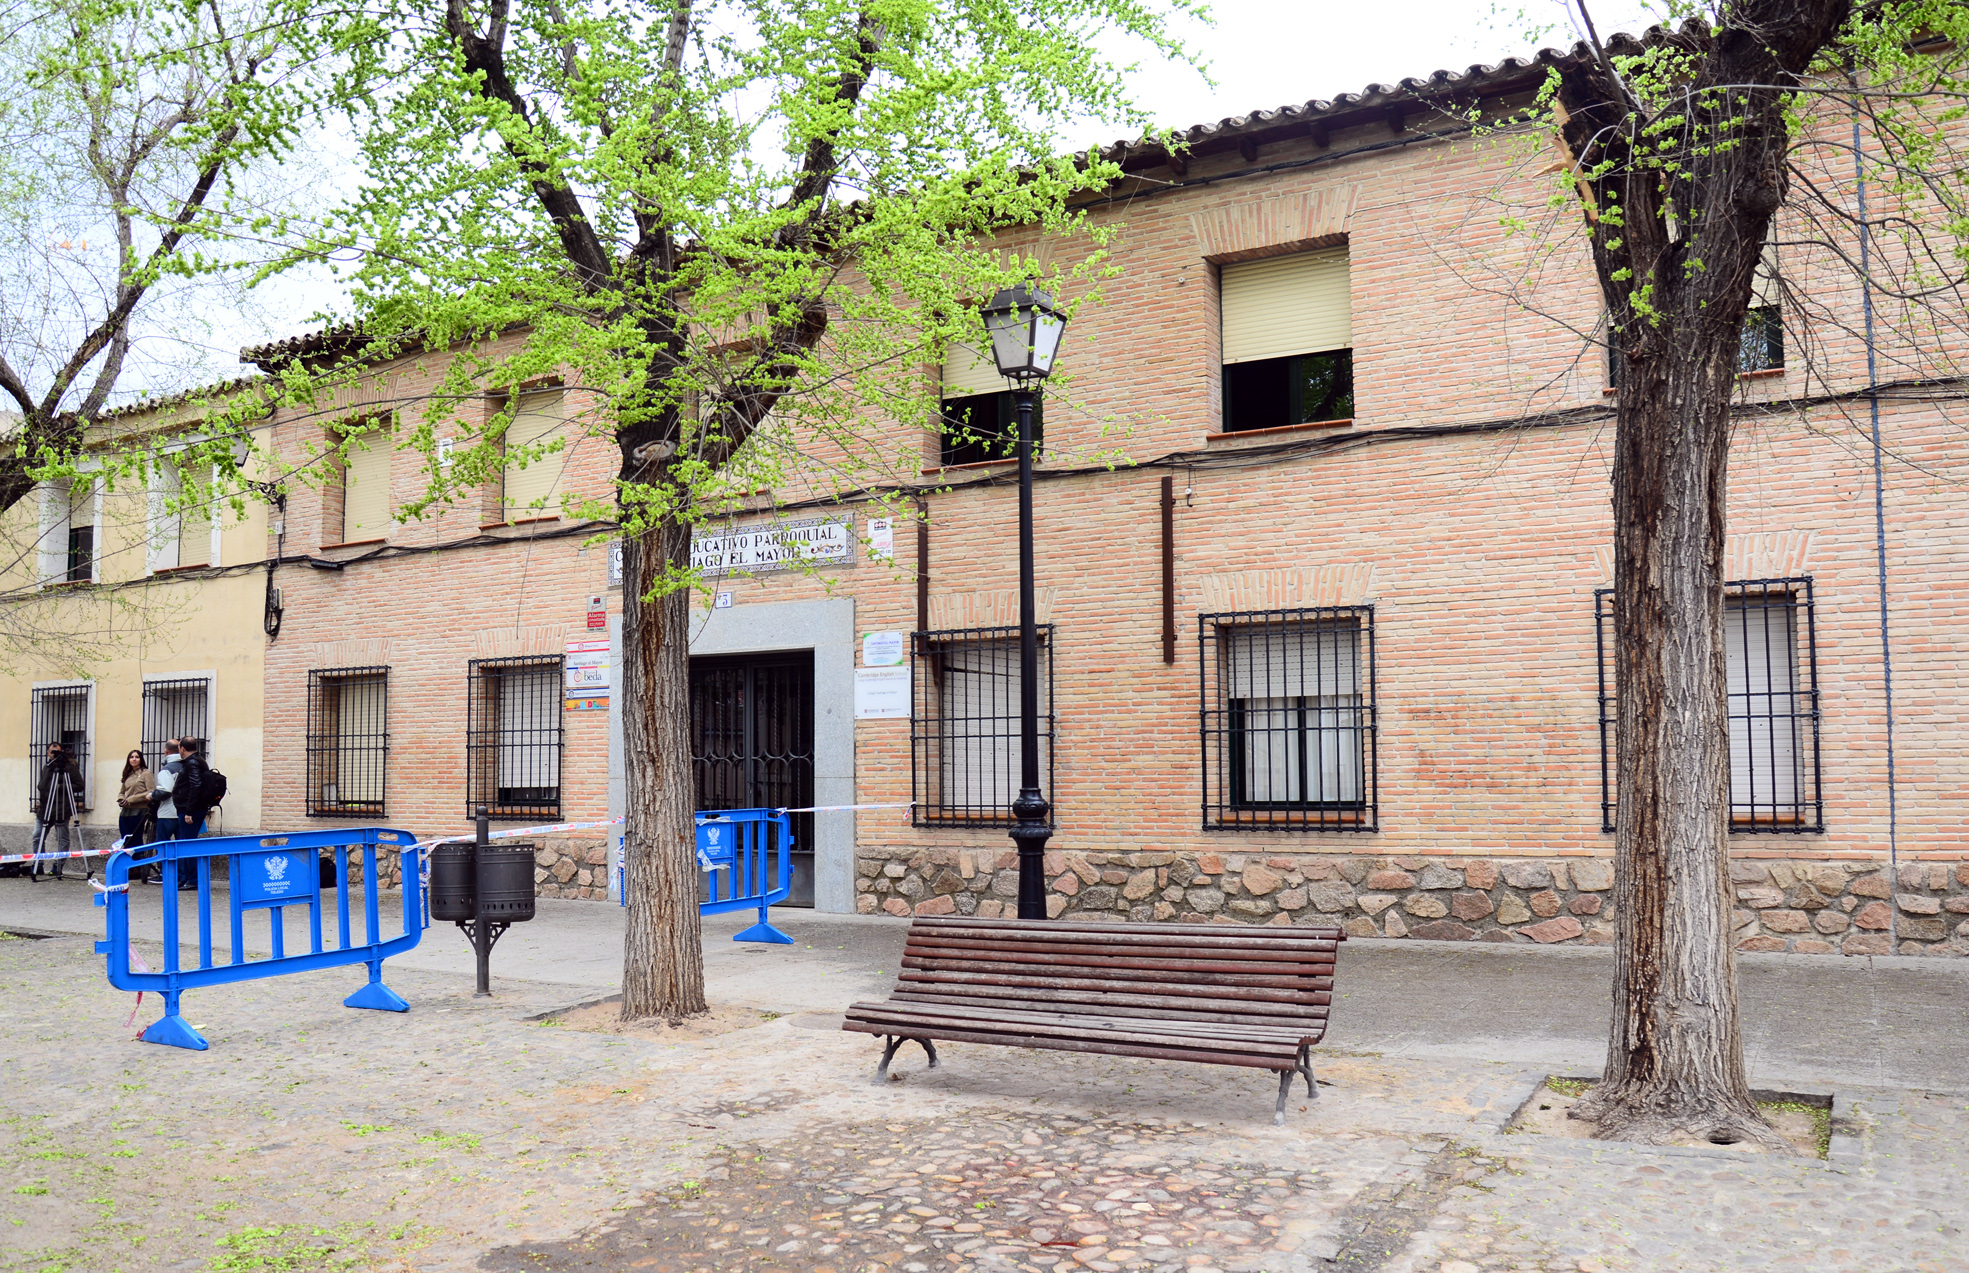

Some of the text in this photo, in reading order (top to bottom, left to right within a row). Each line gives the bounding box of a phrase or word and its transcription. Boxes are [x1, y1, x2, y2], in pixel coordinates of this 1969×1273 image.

[690, 536, 748, 554] DUCATIVO
[730, 551, 748, 565] EL
[722, 594, 728, 606] 3
[583, 670, 602, 681] beda
